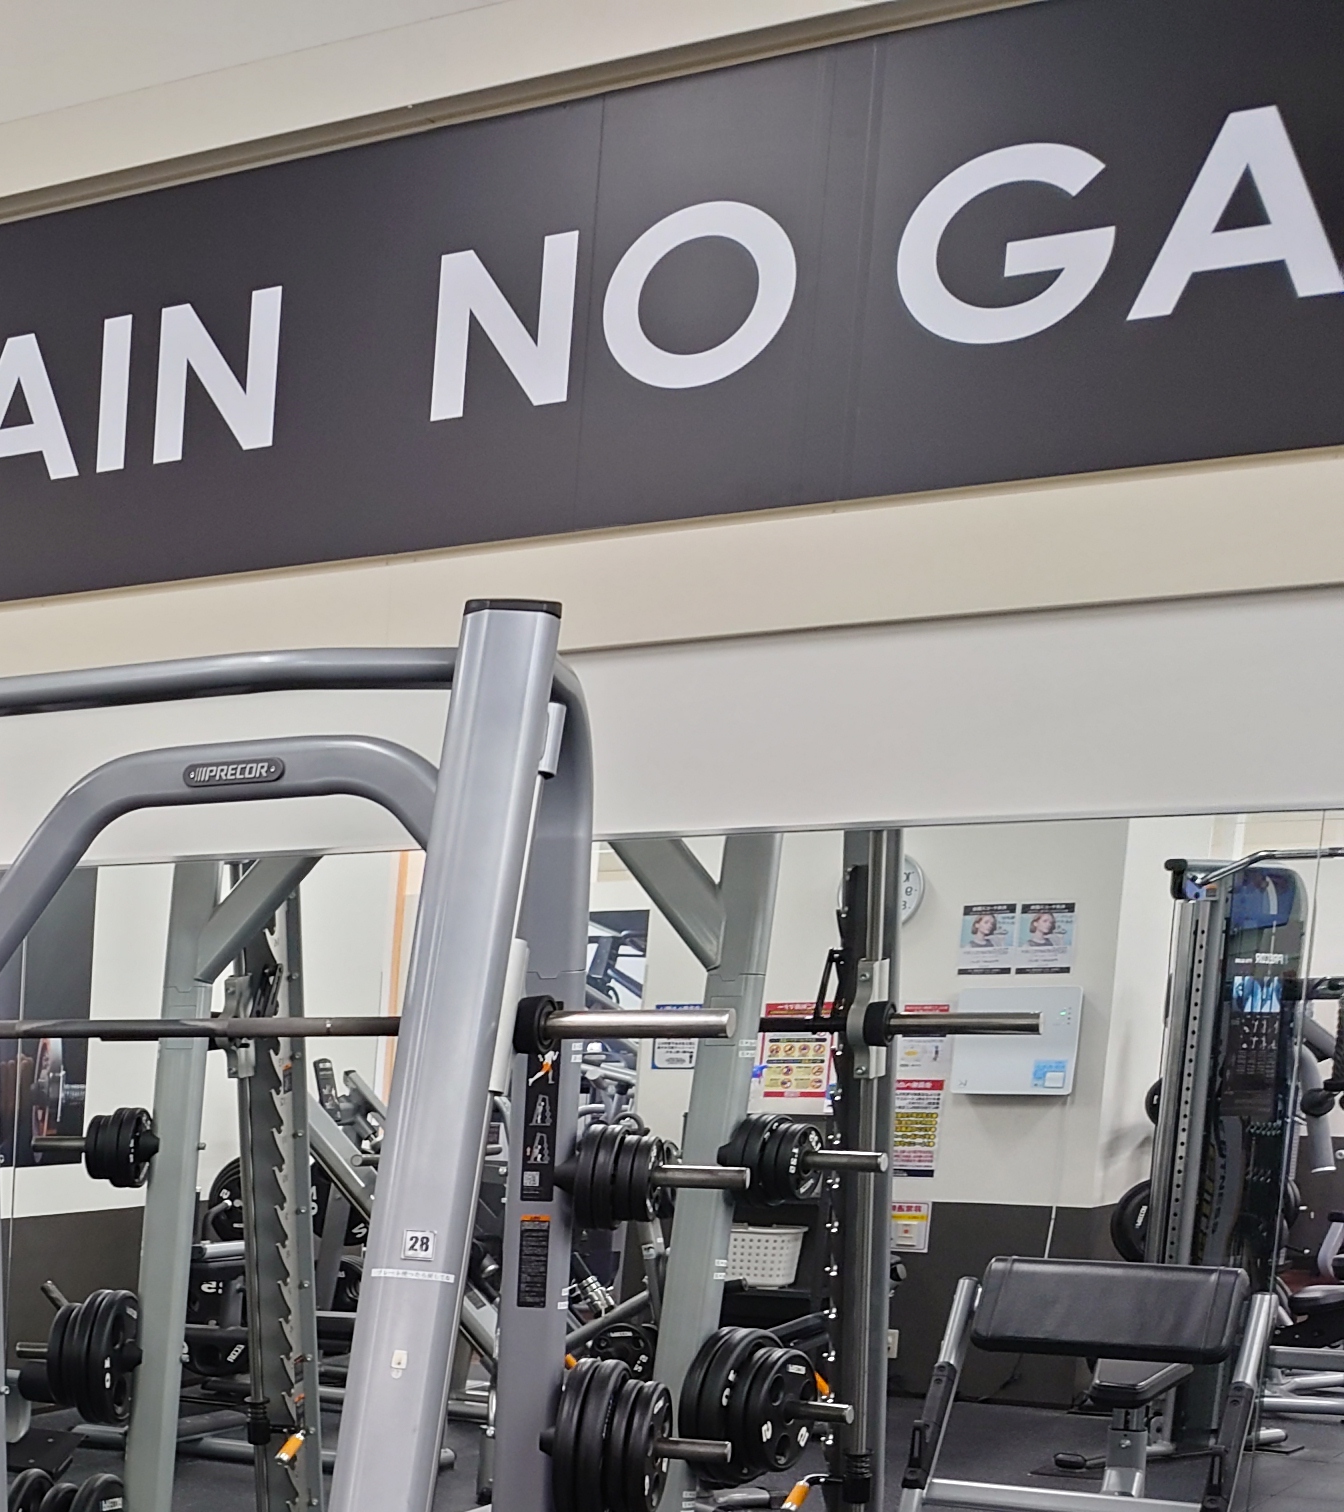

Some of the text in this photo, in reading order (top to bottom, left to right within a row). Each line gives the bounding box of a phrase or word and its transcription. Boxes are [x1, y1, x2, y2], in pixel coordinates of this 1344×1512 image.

[429, 200, 797, 421] NO
[896, 104, 1344, 345] GA
[205, 763, 269, 781] PRECOR
[408, 1235, 430, 1253] 28
